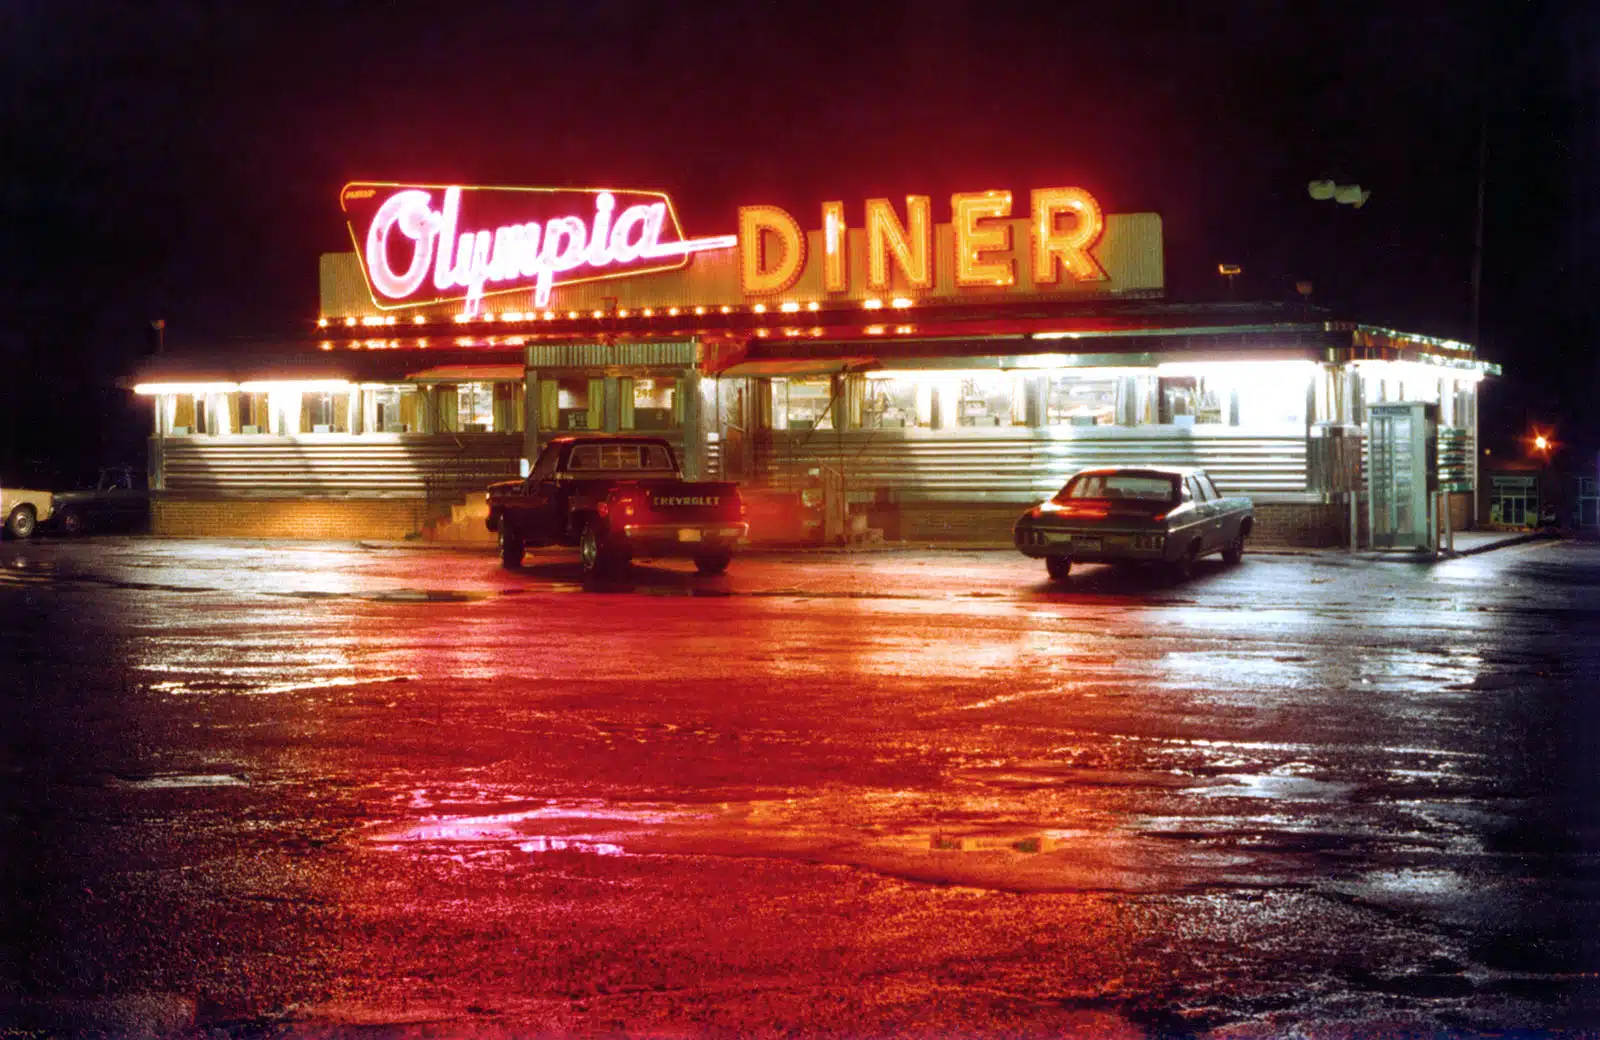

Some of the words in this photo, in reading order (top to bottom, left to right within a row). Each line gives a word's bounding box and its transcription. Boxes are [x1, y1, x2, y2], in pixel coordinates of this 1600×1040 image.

[366, 185, 737, 317] Olympia
[738, 187, 1108, 295] DINER
[653, 496, 721, 506] CHEVROLET
